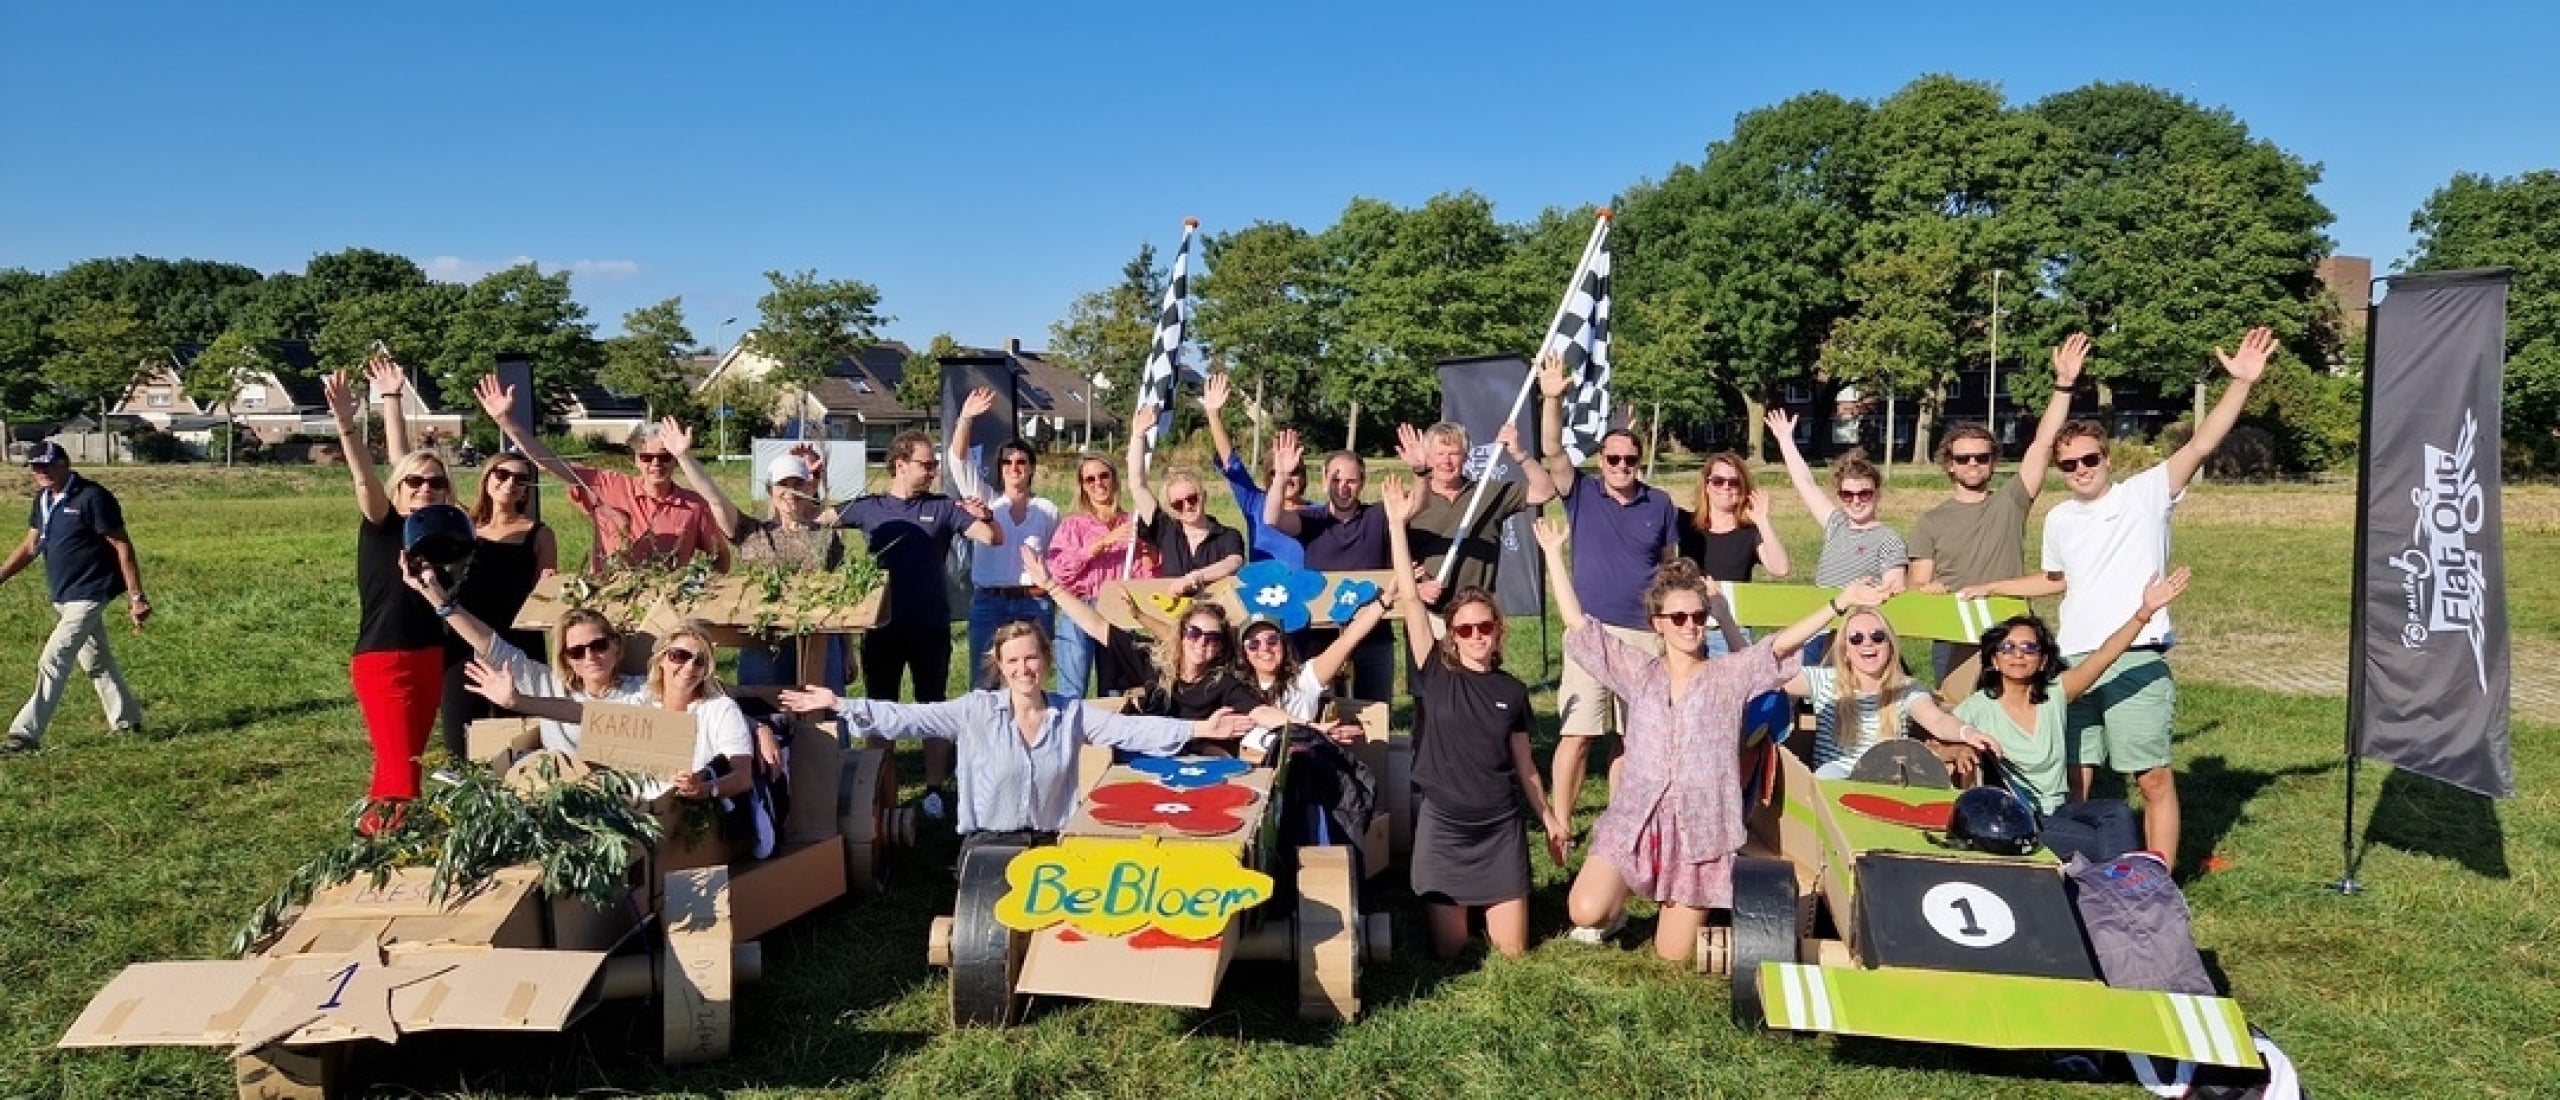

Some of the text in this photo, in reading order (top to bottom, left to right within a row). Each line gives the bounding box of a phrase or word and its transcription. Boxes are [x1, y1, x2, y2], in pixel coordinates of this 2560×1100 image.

[2431, 452, 2470, 626] Flat Out
[589, 711, 654, 741] KARIN
[1950, 897, 1987, 936] 1
[317, 961, 360, 1011] 1
